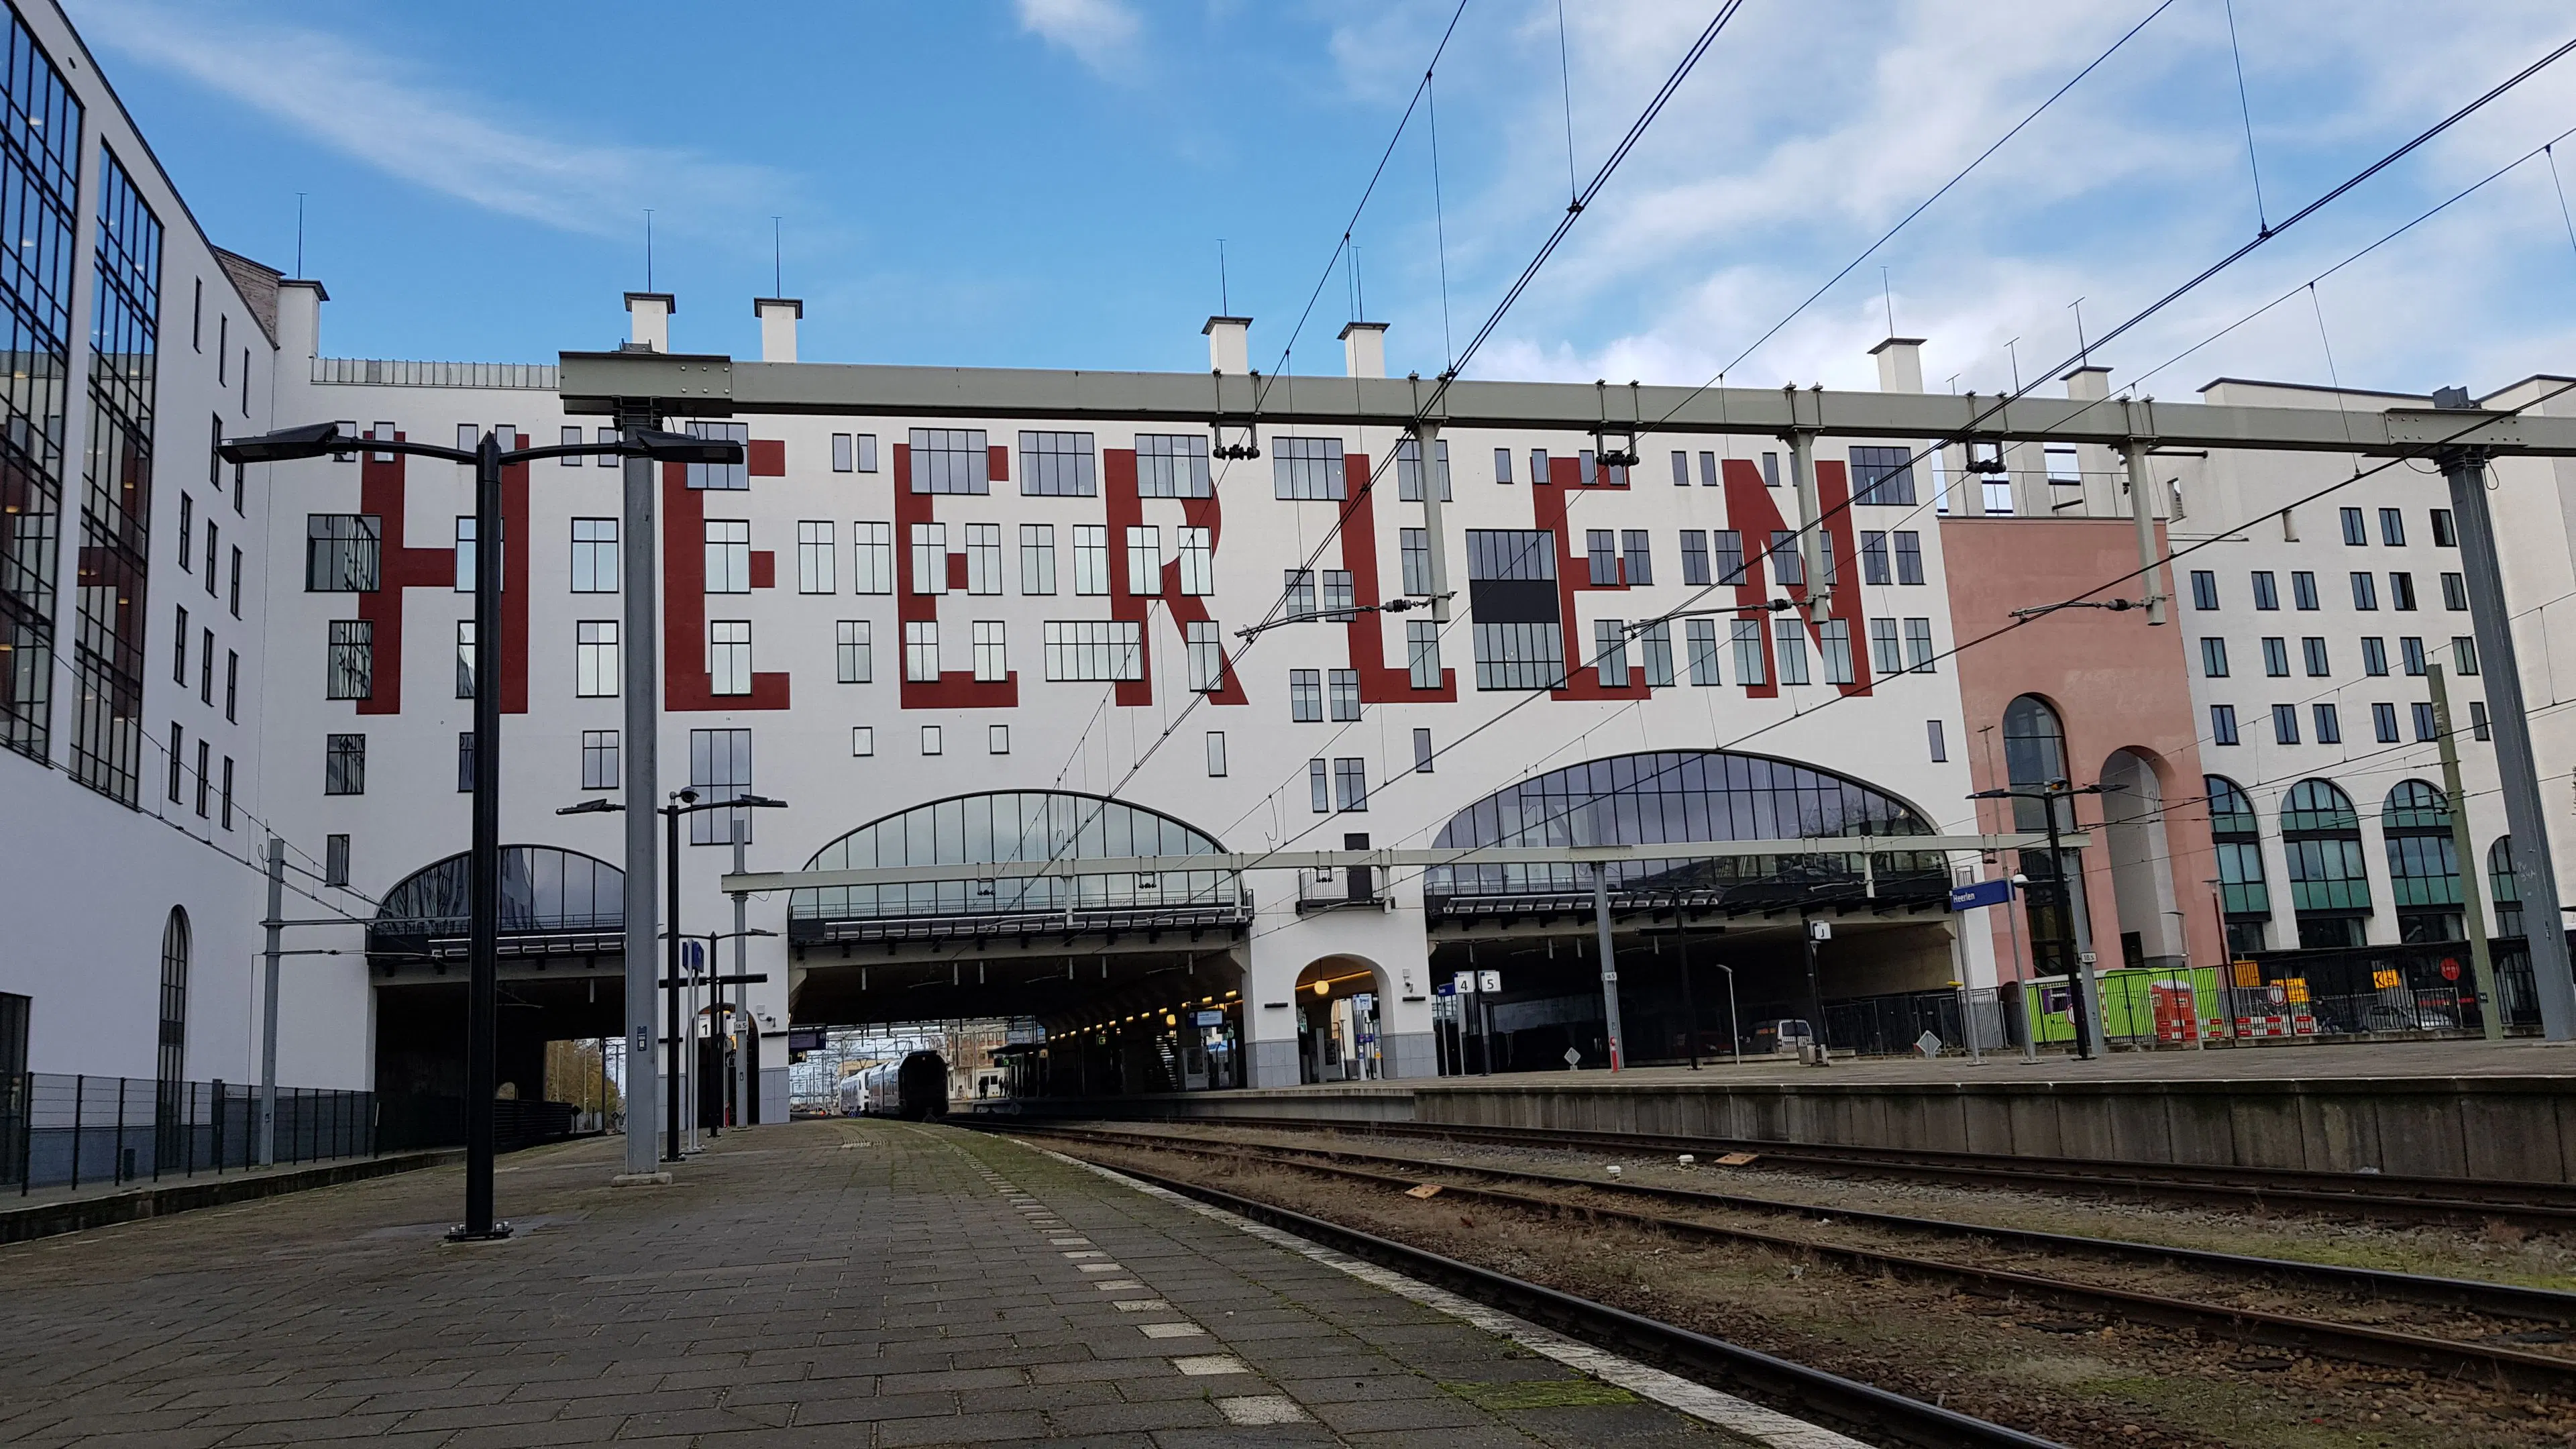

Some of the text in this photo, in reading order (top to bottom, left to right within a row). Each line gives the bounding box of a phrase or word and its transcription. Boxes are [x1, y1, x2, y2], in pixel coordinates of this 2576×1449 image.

[356, 431, 1873, 716] HEERLEN
[1952, 892, 1976, 904] Heerlen
[1460, 980, 1468, 991] 4
[1487, 978, 1495, 989] 5
[702, 1024, 708, 1036] 1
